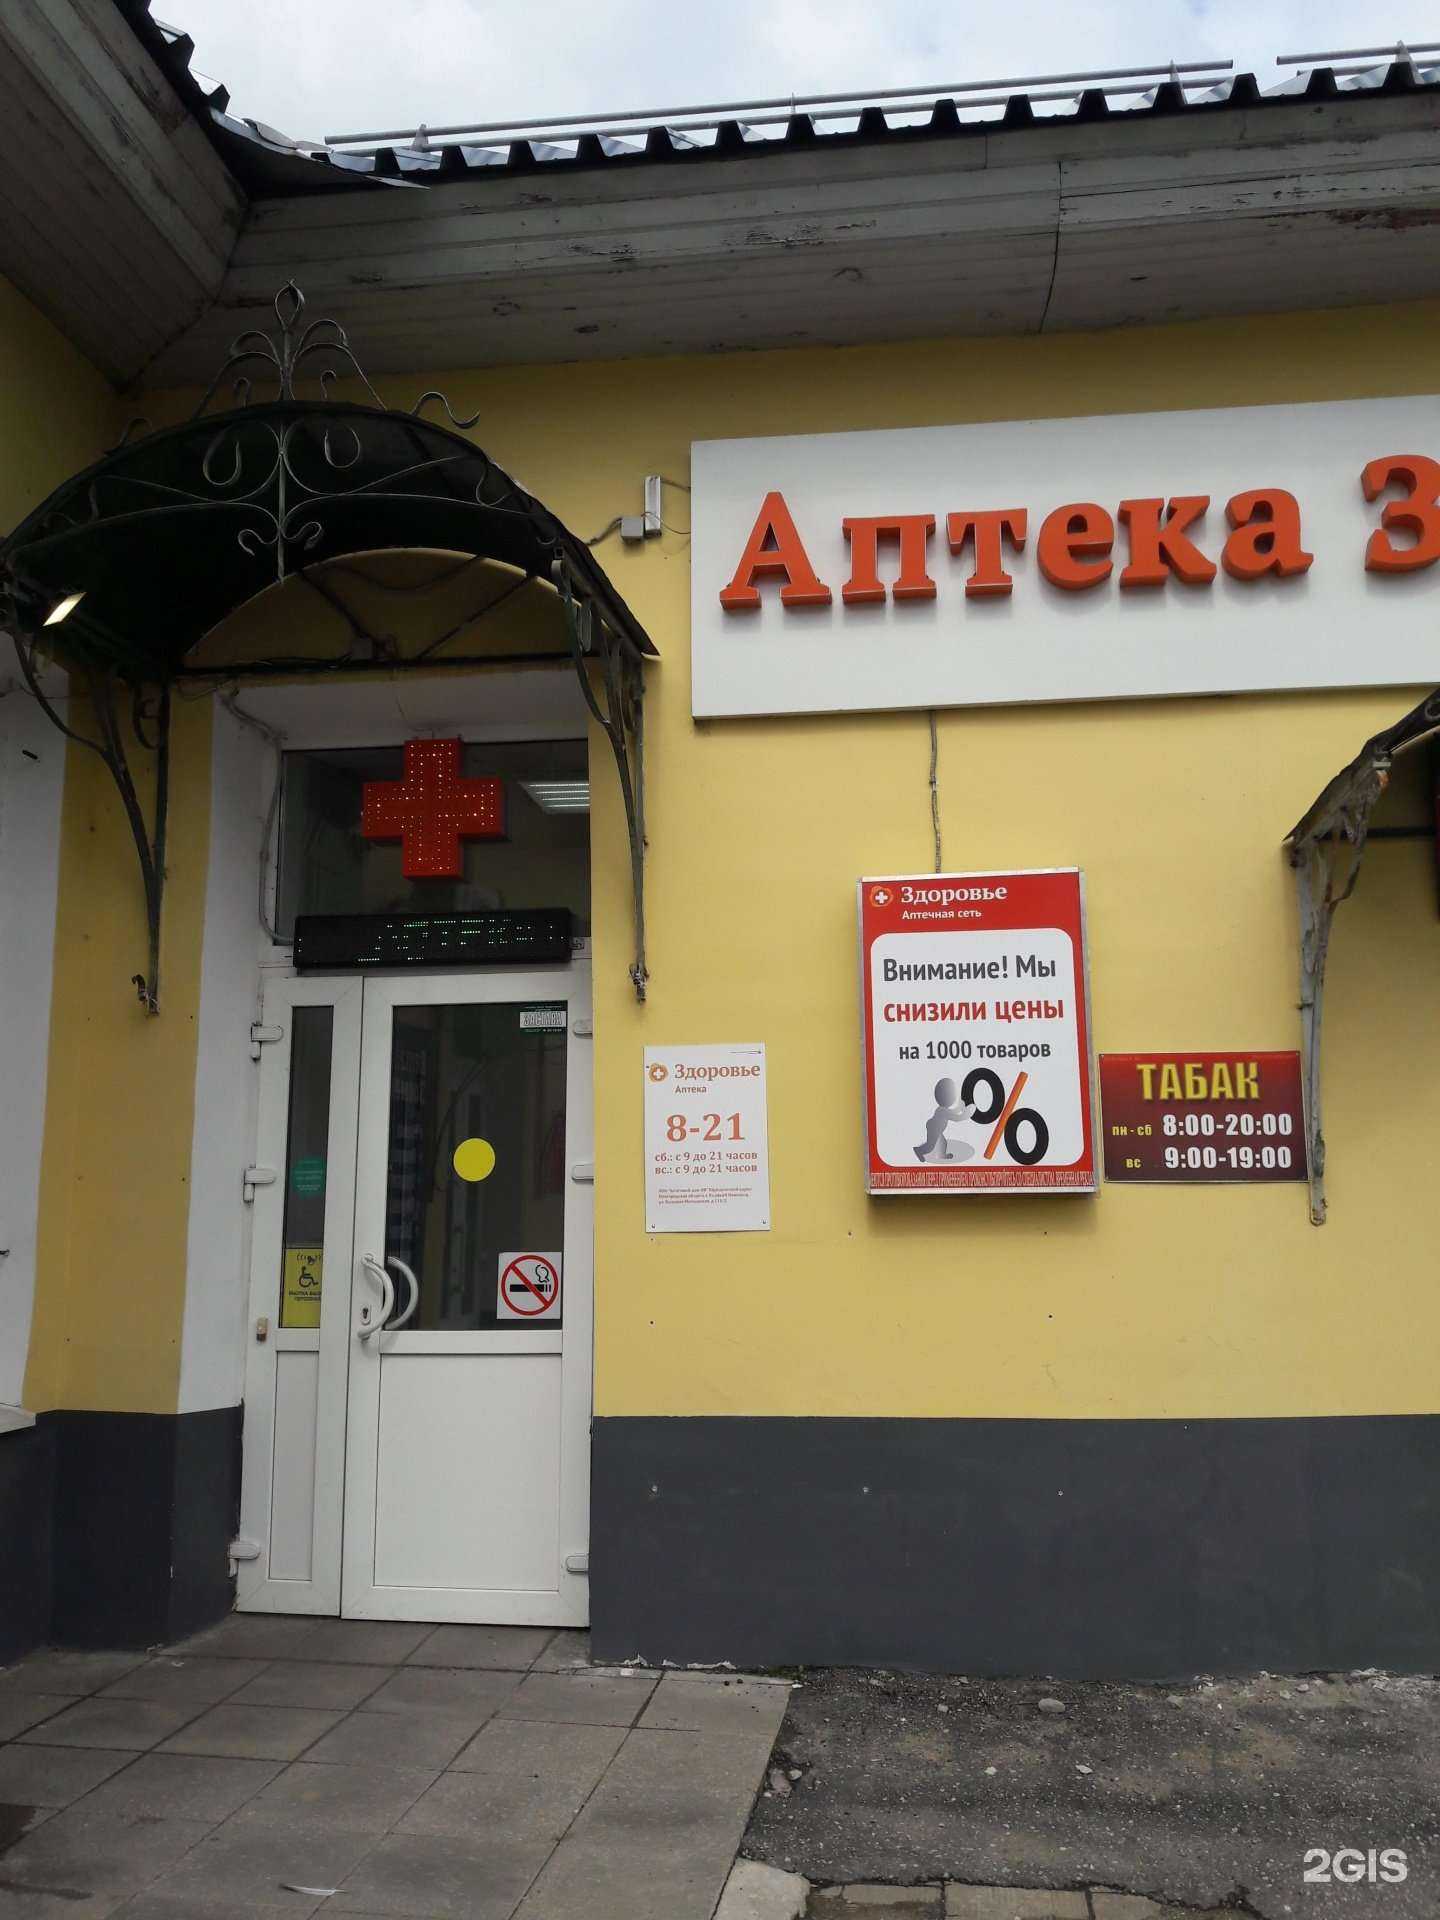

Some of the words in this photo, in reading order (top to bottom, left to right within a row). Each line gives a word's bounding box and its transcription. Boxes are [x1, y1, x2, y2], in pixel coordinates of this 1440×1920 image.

[720, 488, 1314, 609] Аптека
[901, 885, 1008, 906] Здоровье
[902, 910, 954, 920] Аптечная
[957, 909, 982, 918] сеть
[883, 955, 1008, 981] Внимание!
[1016, 955, 1056, 977] Мы
[883, 1000, 987, 1023] снизили
[995, 999, 1064, 1023] цены
[899, 1044, 920, 1060] на
[926, 1041, 972, 1059] 1000
[976, 1042, 1051, 1062] товаров
[675, 1063, 761, 1082] Здоровье
[1136, 1062, 1260, 1100] ТАБАК
[675, 1085, 707, 1094] Аптека
[666, 1112, 745, 1142] 8-21
[1162, 1113, 1293, 1136] 8:00-20:00
[675, 1153, 681, 1161] с
[683, 1152, 690, 1161] 9
[693, 1153, 707, 1162] до
[709, 1151, 722, 1160] 21
[726, 1152, 758, 1160] часов
[1125, 1158, 1142, 1169] вс
[1164, 1146, 1292, 1169] 9:00-19:00
[675, 1166, 681, 1174] с
[683, 1164, 690, 1173] 9
[693, 1166, 707, 1175] до
[709, 1164, 722, 1173] 21
[726, 1164, 758, 1173] часов
